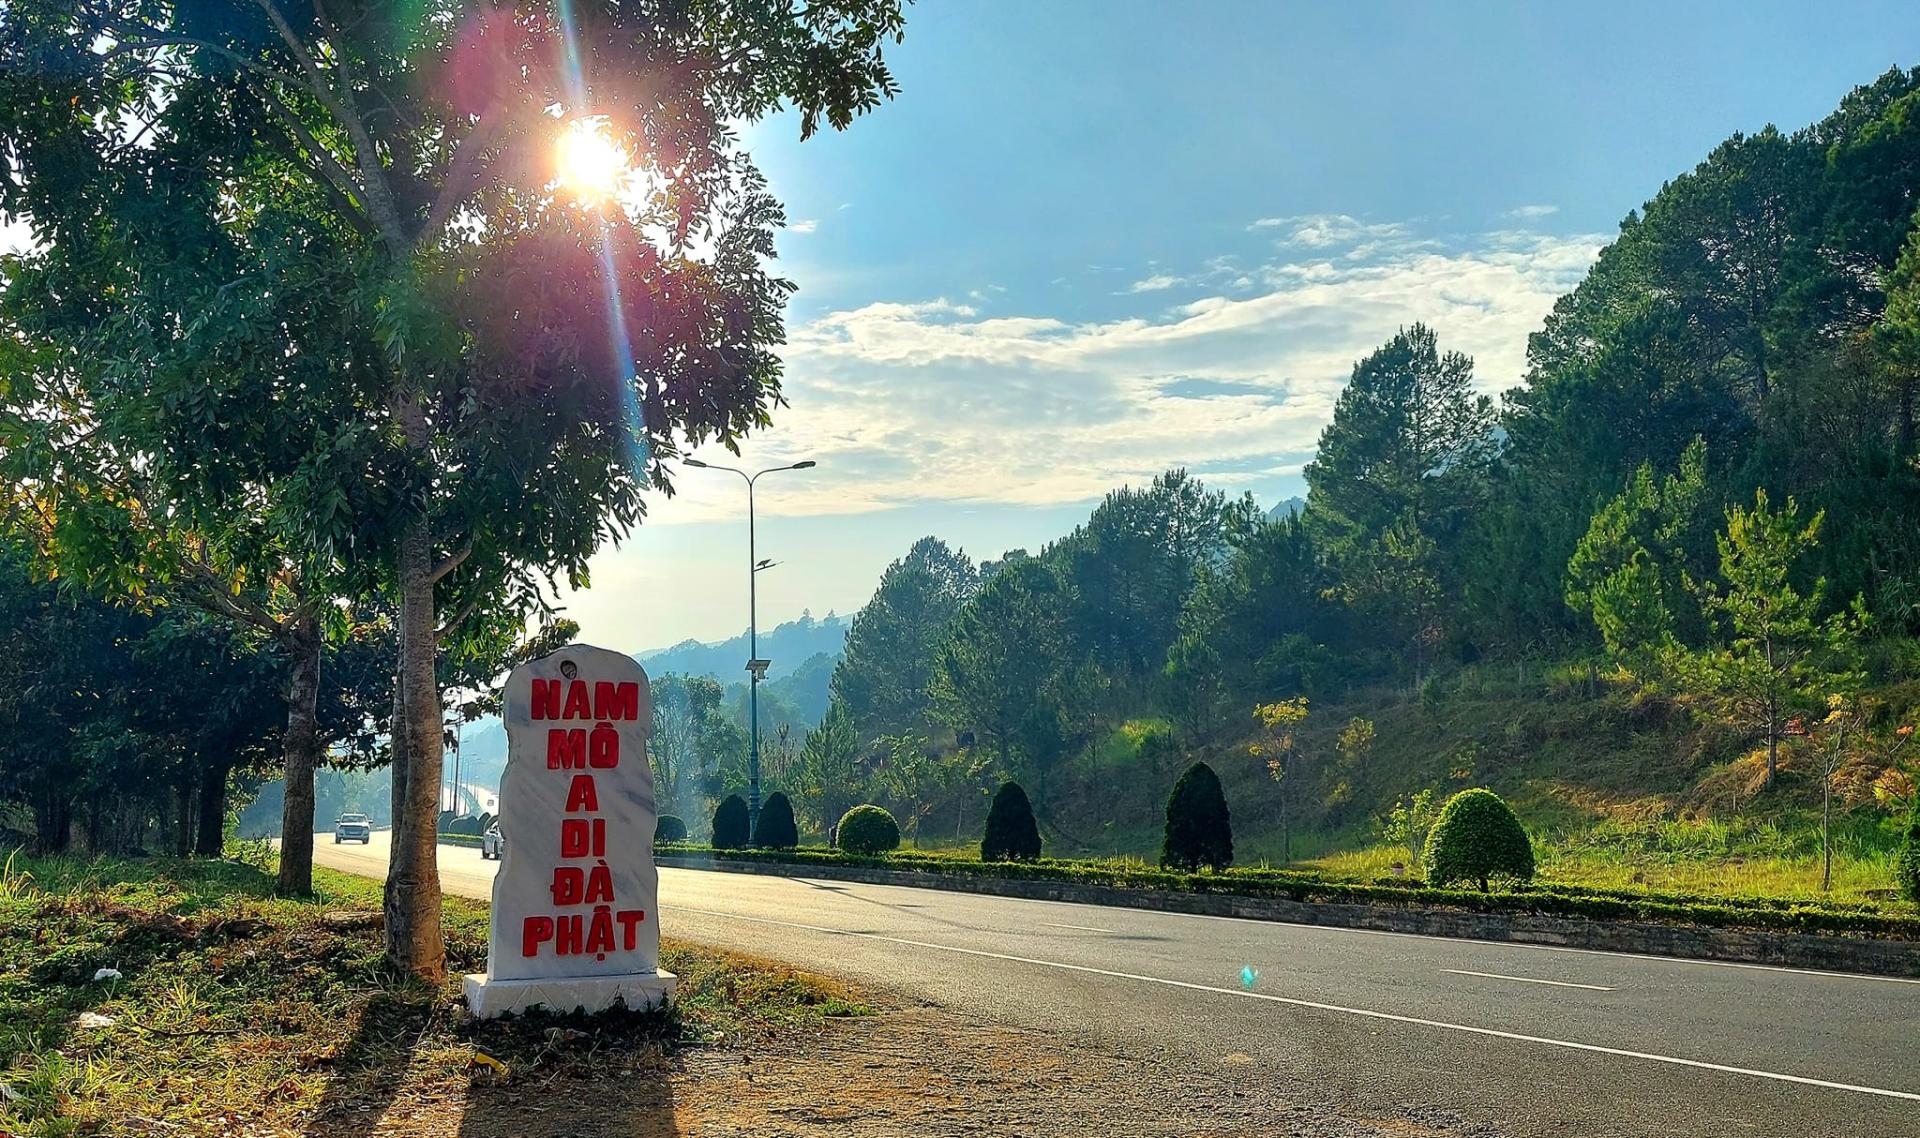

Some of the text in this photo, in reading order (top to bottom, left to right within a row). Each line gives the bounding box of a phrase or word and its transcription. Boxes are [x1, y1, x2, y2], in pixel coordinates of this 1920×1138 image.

[531, 679, 639, 721] NAM
[547, 722, 620, 769] MÔ
[565, 775, 598, 813] A
[561, 818, 606, 859] DI
[550, 859, 615, 906] ĐÀ
[523, 905, 644, 961] PHẬT
